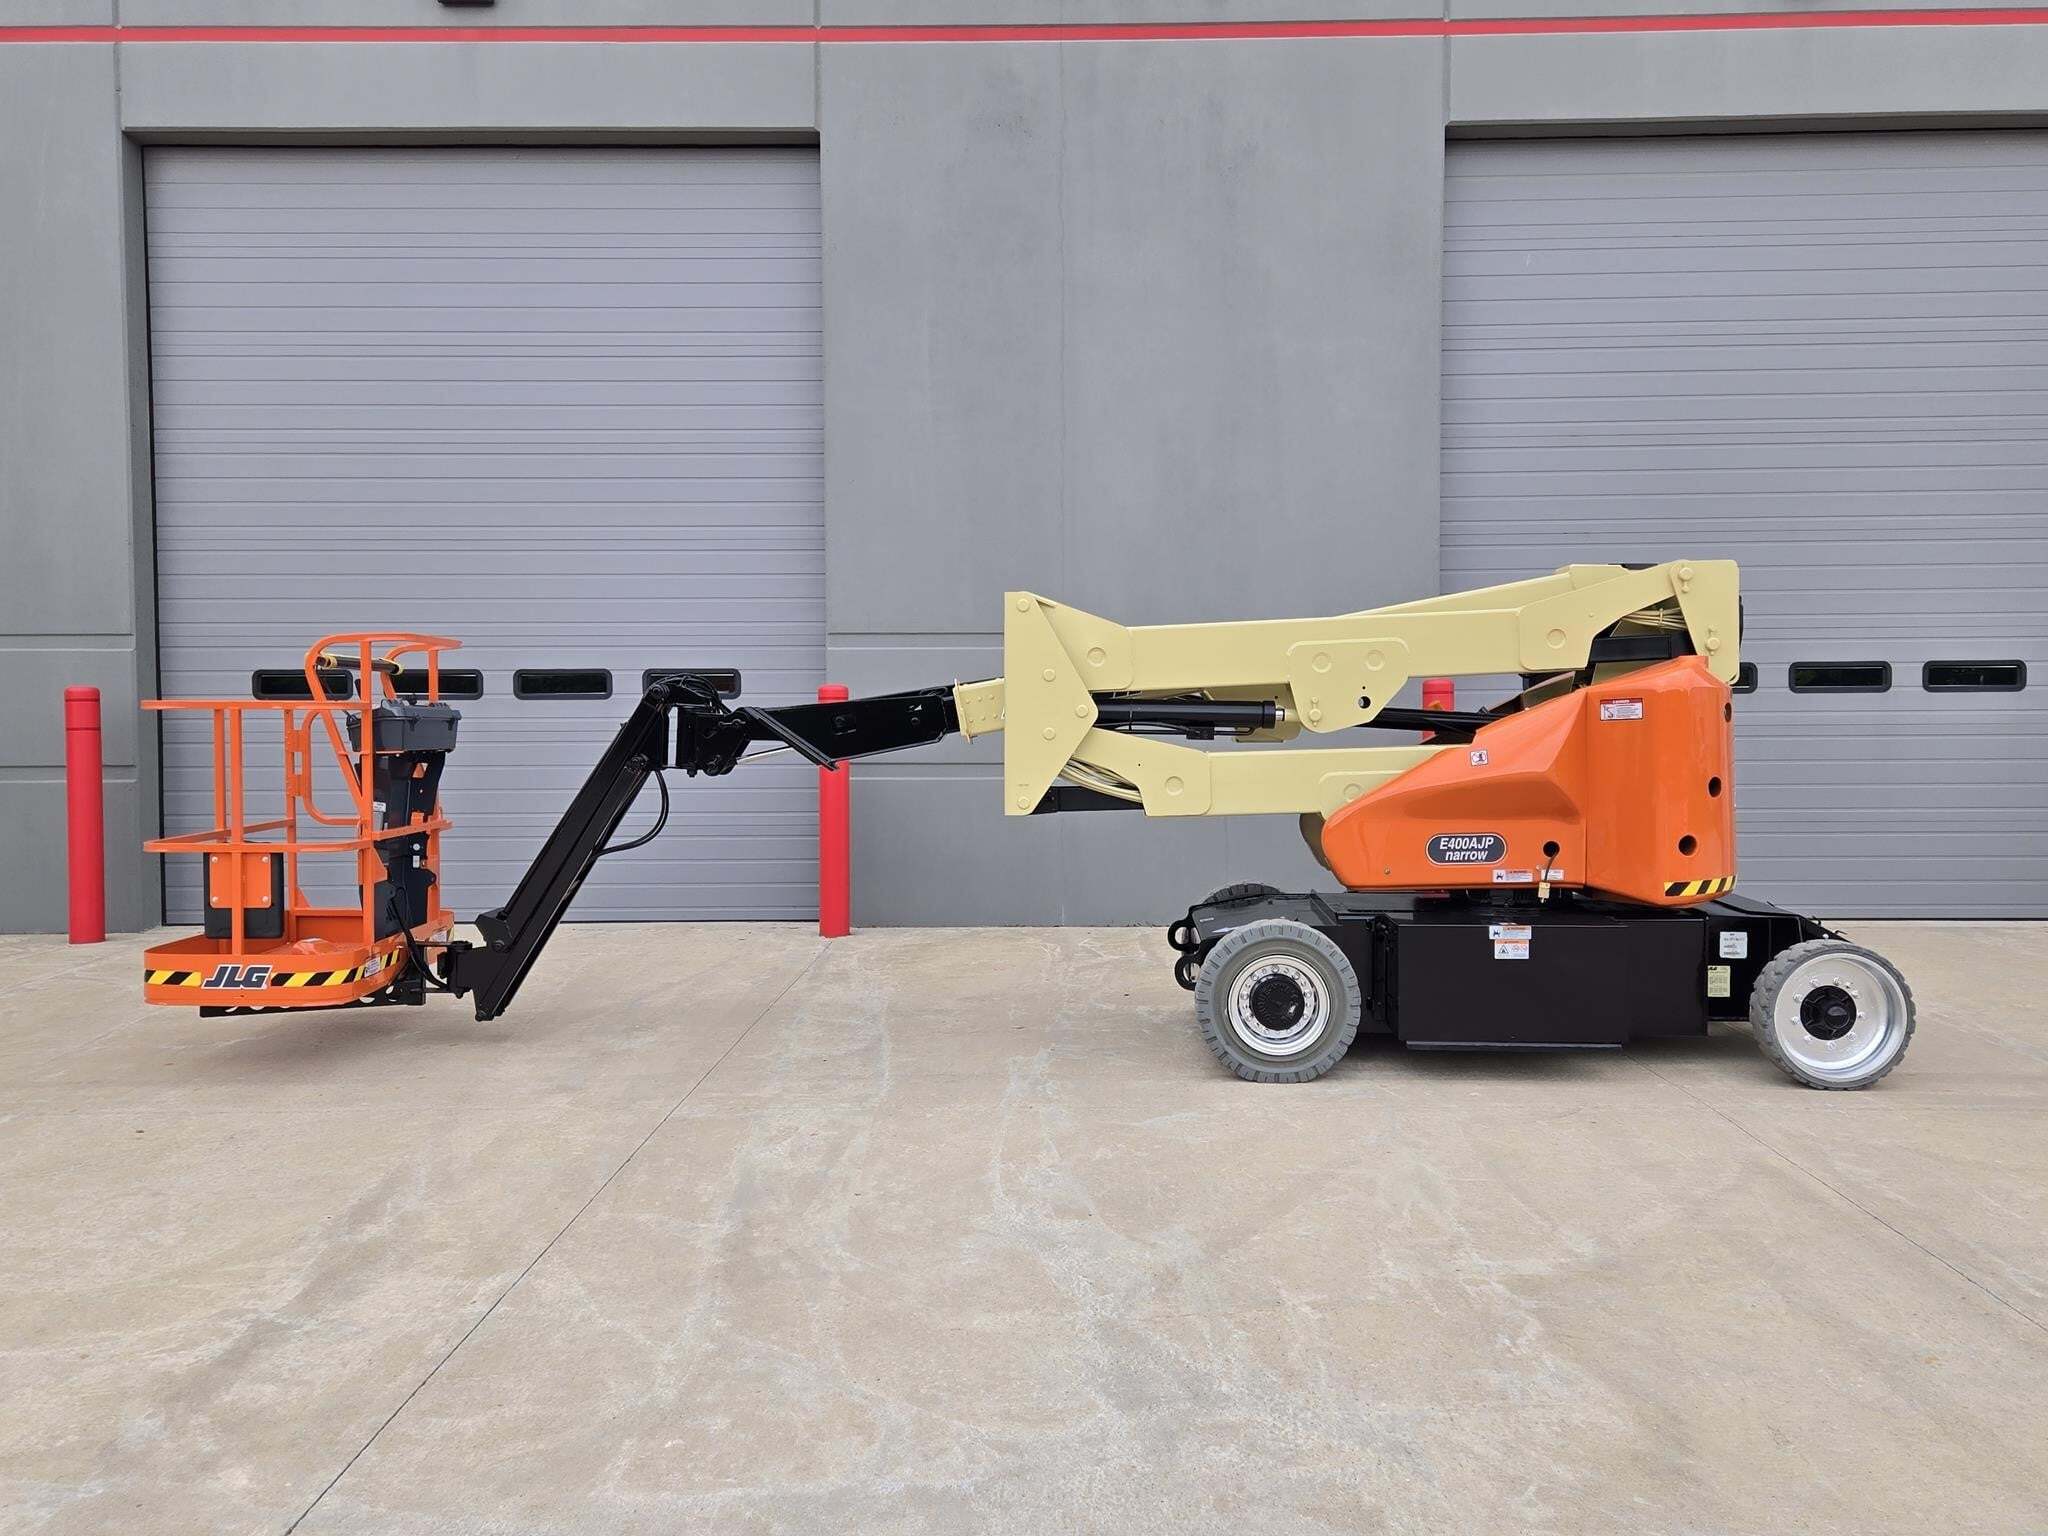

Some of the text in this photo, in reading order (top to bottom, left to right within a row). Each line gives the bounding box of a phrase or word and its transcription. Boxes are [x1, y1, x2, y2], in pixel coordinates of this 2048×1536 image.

[1440, 837, 1494, 850] E400AJP
[1445, 850, 1488, 861] narrow
[202, 965, 272, 989] JLG
